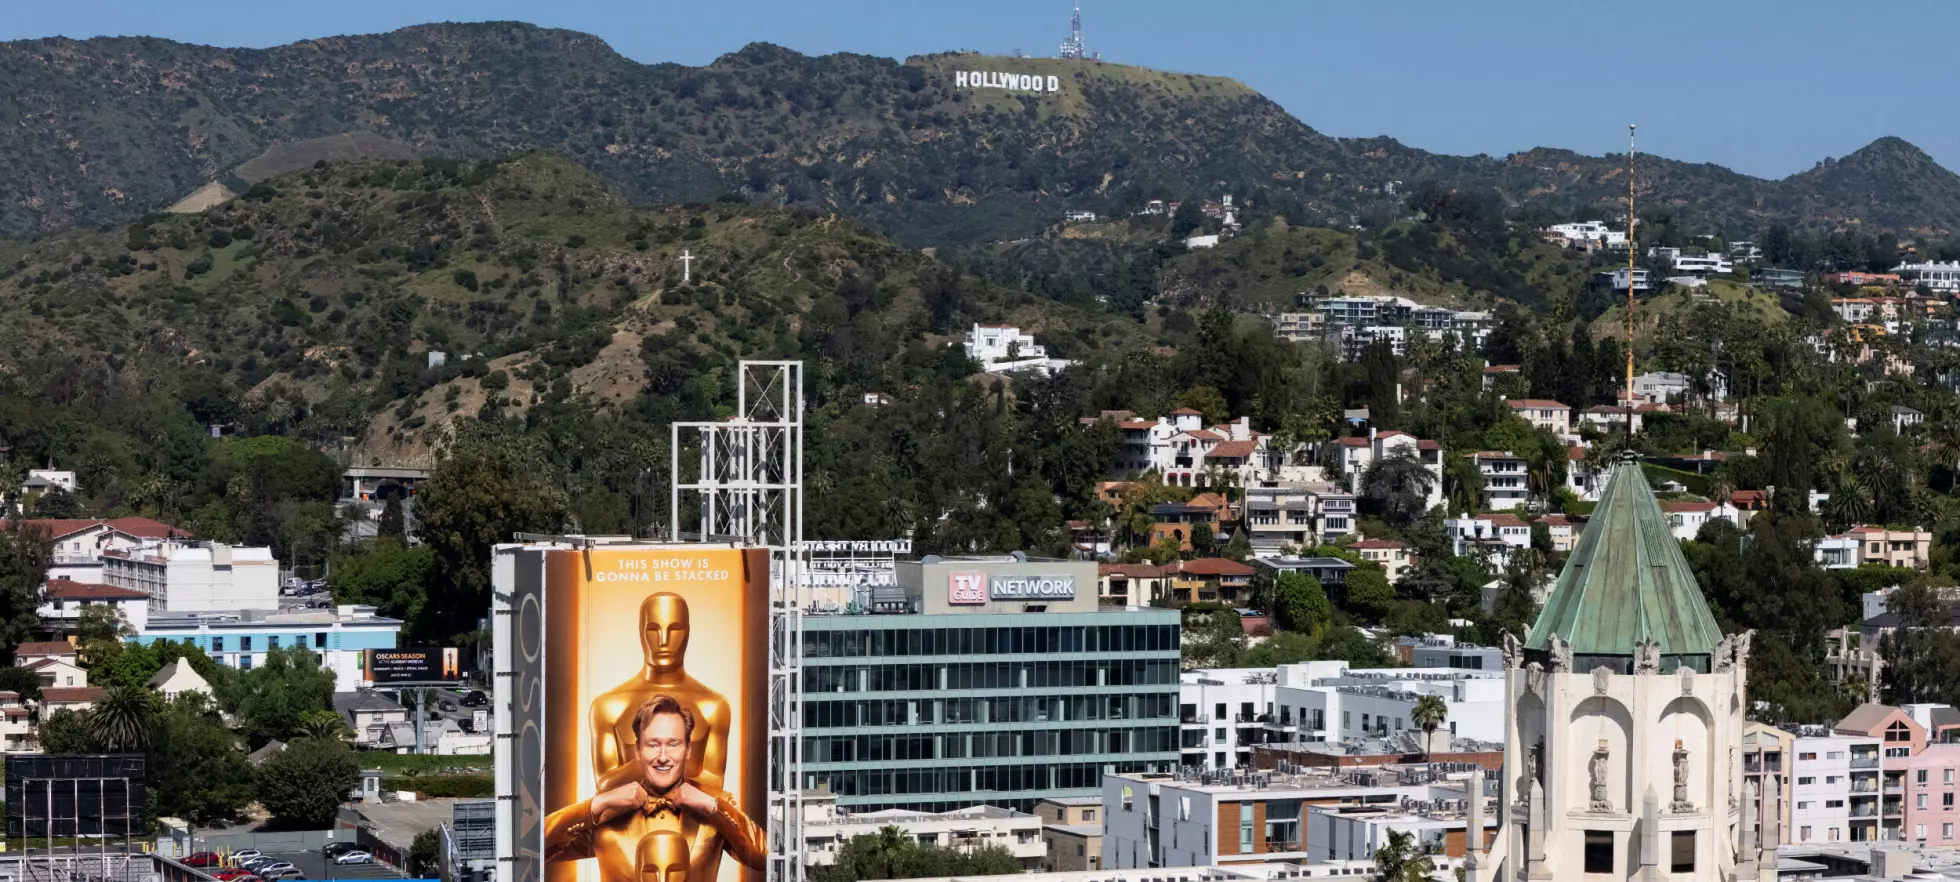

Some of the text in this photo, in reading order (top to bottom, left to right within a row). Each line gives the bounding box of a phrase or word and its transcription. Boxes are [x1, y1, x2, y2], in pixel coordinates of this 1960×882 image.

[955, 70, 1059, 92] HOLLYWOOD
[618, 558, 710, 569] THIS SHOW IS
[596, 569, 729, 582] GONNA BE STACKED
[955, 575, 982, 590] TV
[993, 579, 1074, 596] NETWORK
[953, 590, 983, 600] GUIDE
